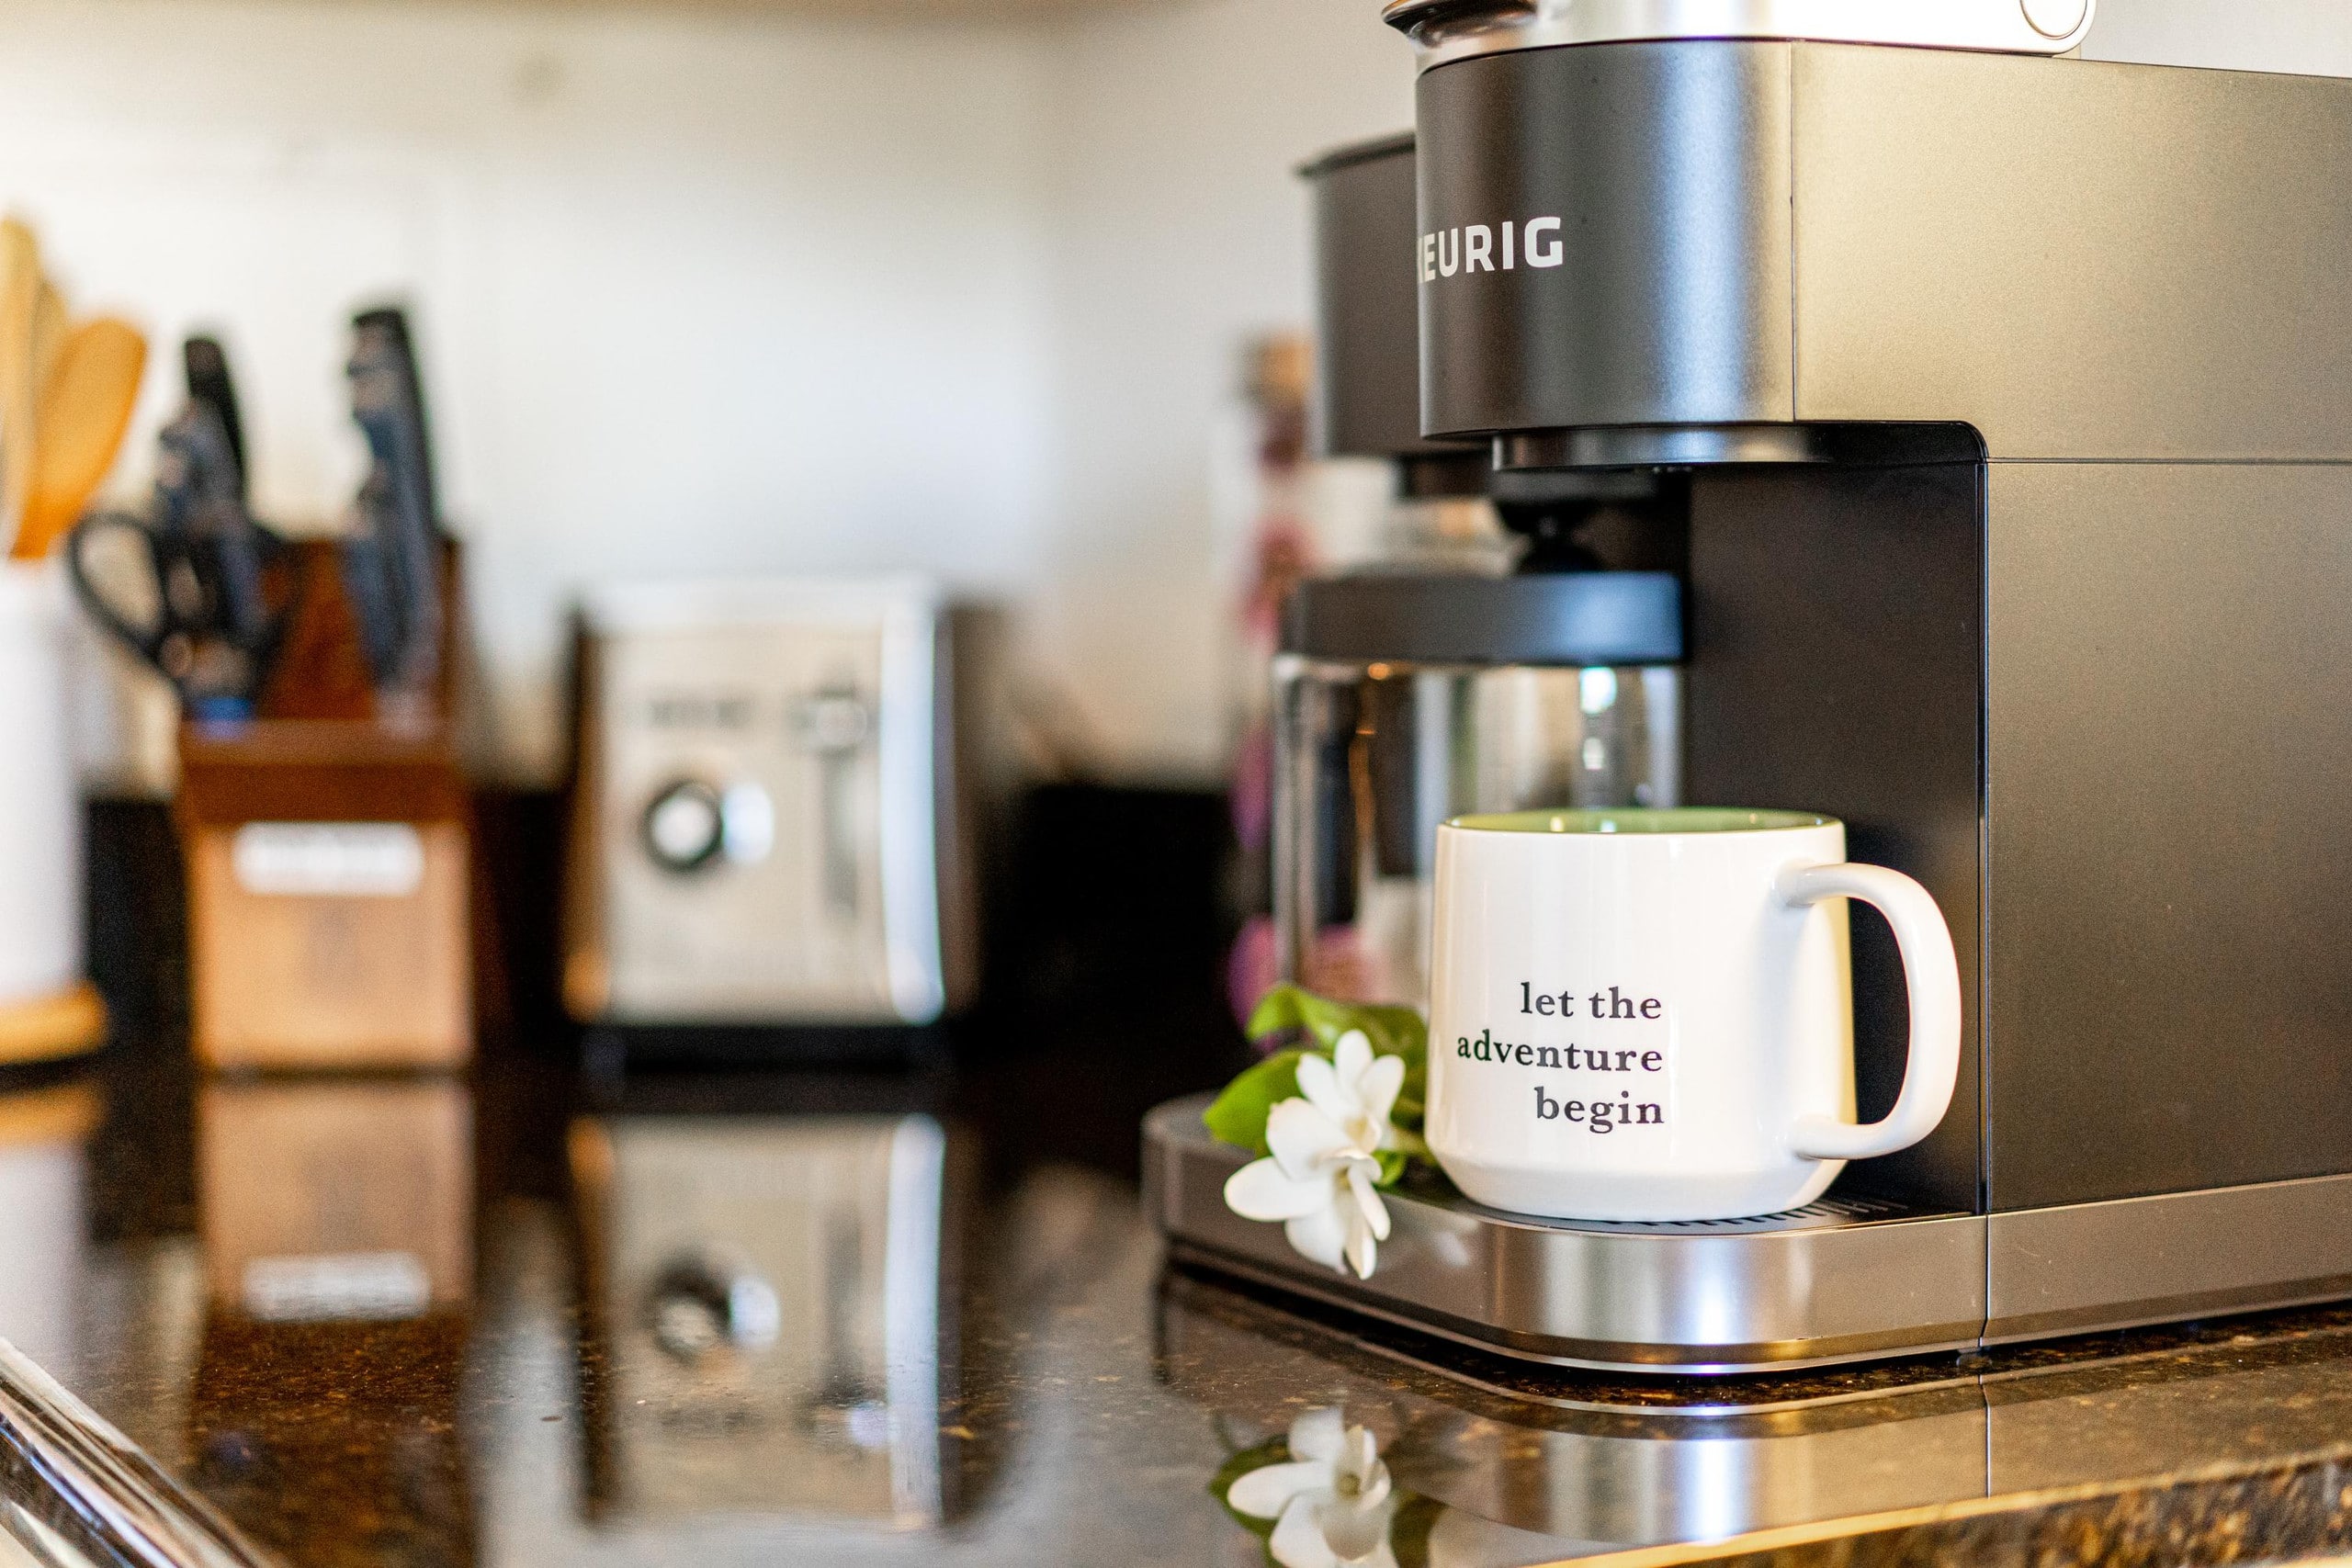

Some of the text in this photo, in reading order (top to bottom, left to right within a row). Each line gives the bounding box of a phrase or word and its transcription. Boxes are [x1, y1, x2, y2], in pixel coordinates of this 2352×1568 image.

[1520, 981, 1662, 1020] let the
[1457, 1028, 1663, 1072] adventure
[1533, 1086, 1665, 1134] begin
